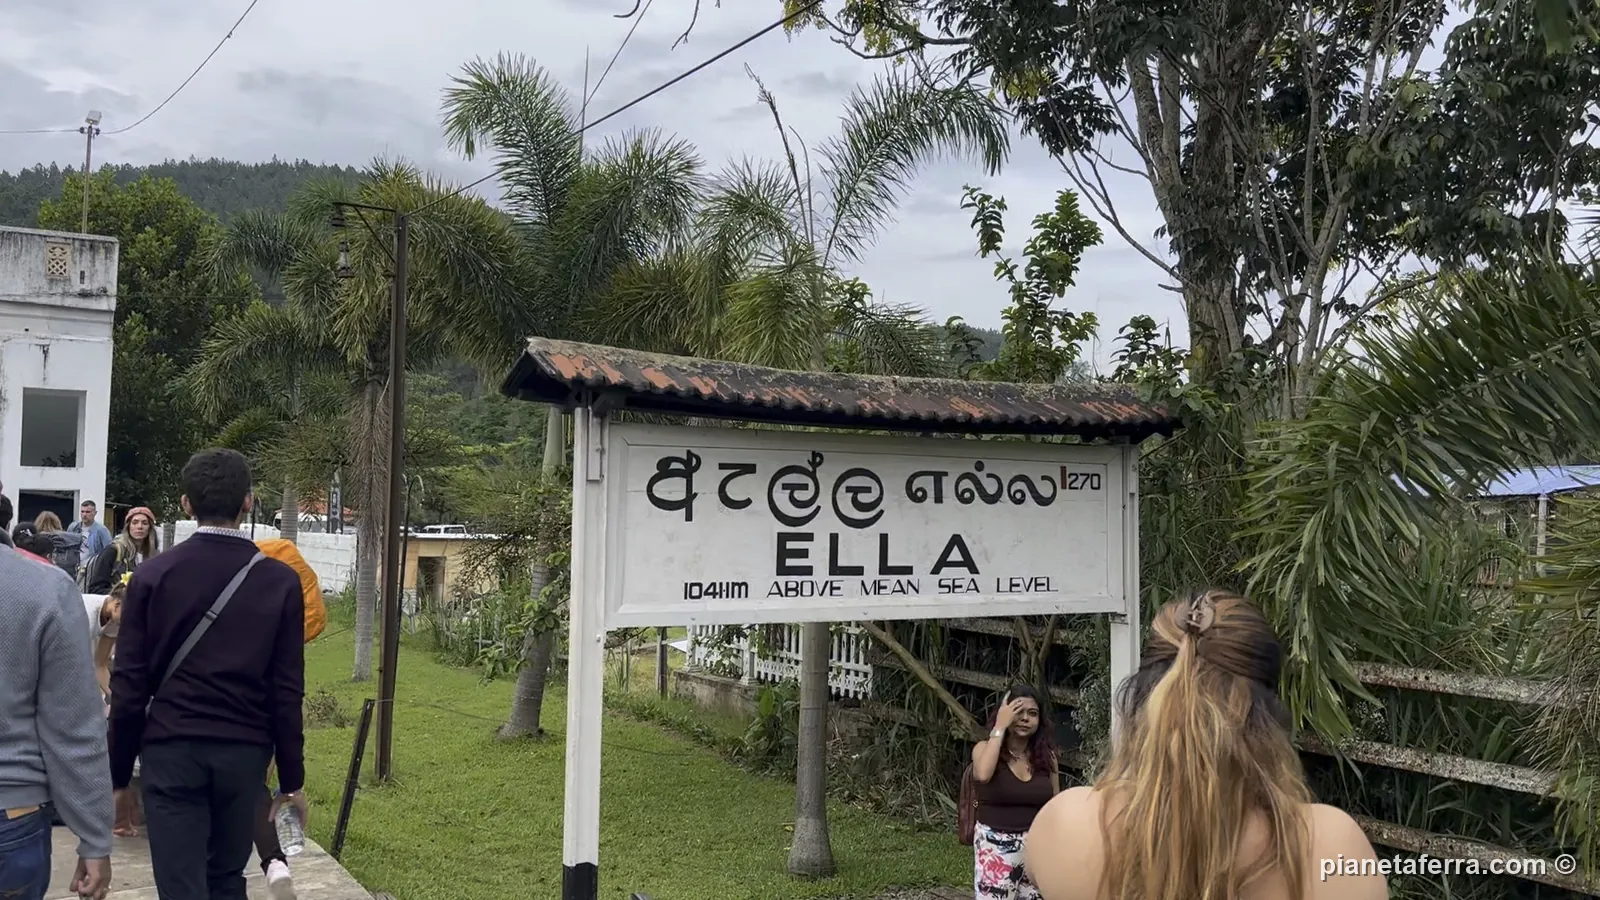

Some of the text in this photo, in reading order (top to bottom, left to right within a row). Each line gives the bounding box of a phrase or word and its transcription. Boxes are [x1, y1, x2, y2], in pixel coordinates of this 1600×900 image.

[905, 460, 1058, 507] எல்ல
[776, 532, 981, 576] ELLA
[767, 580, 845, 598] ABOVE
[860, 578, 920, 596] MEAN
[938, 577, 981, 594] SEA
[996, 576, 1059, 593] LEVEL
